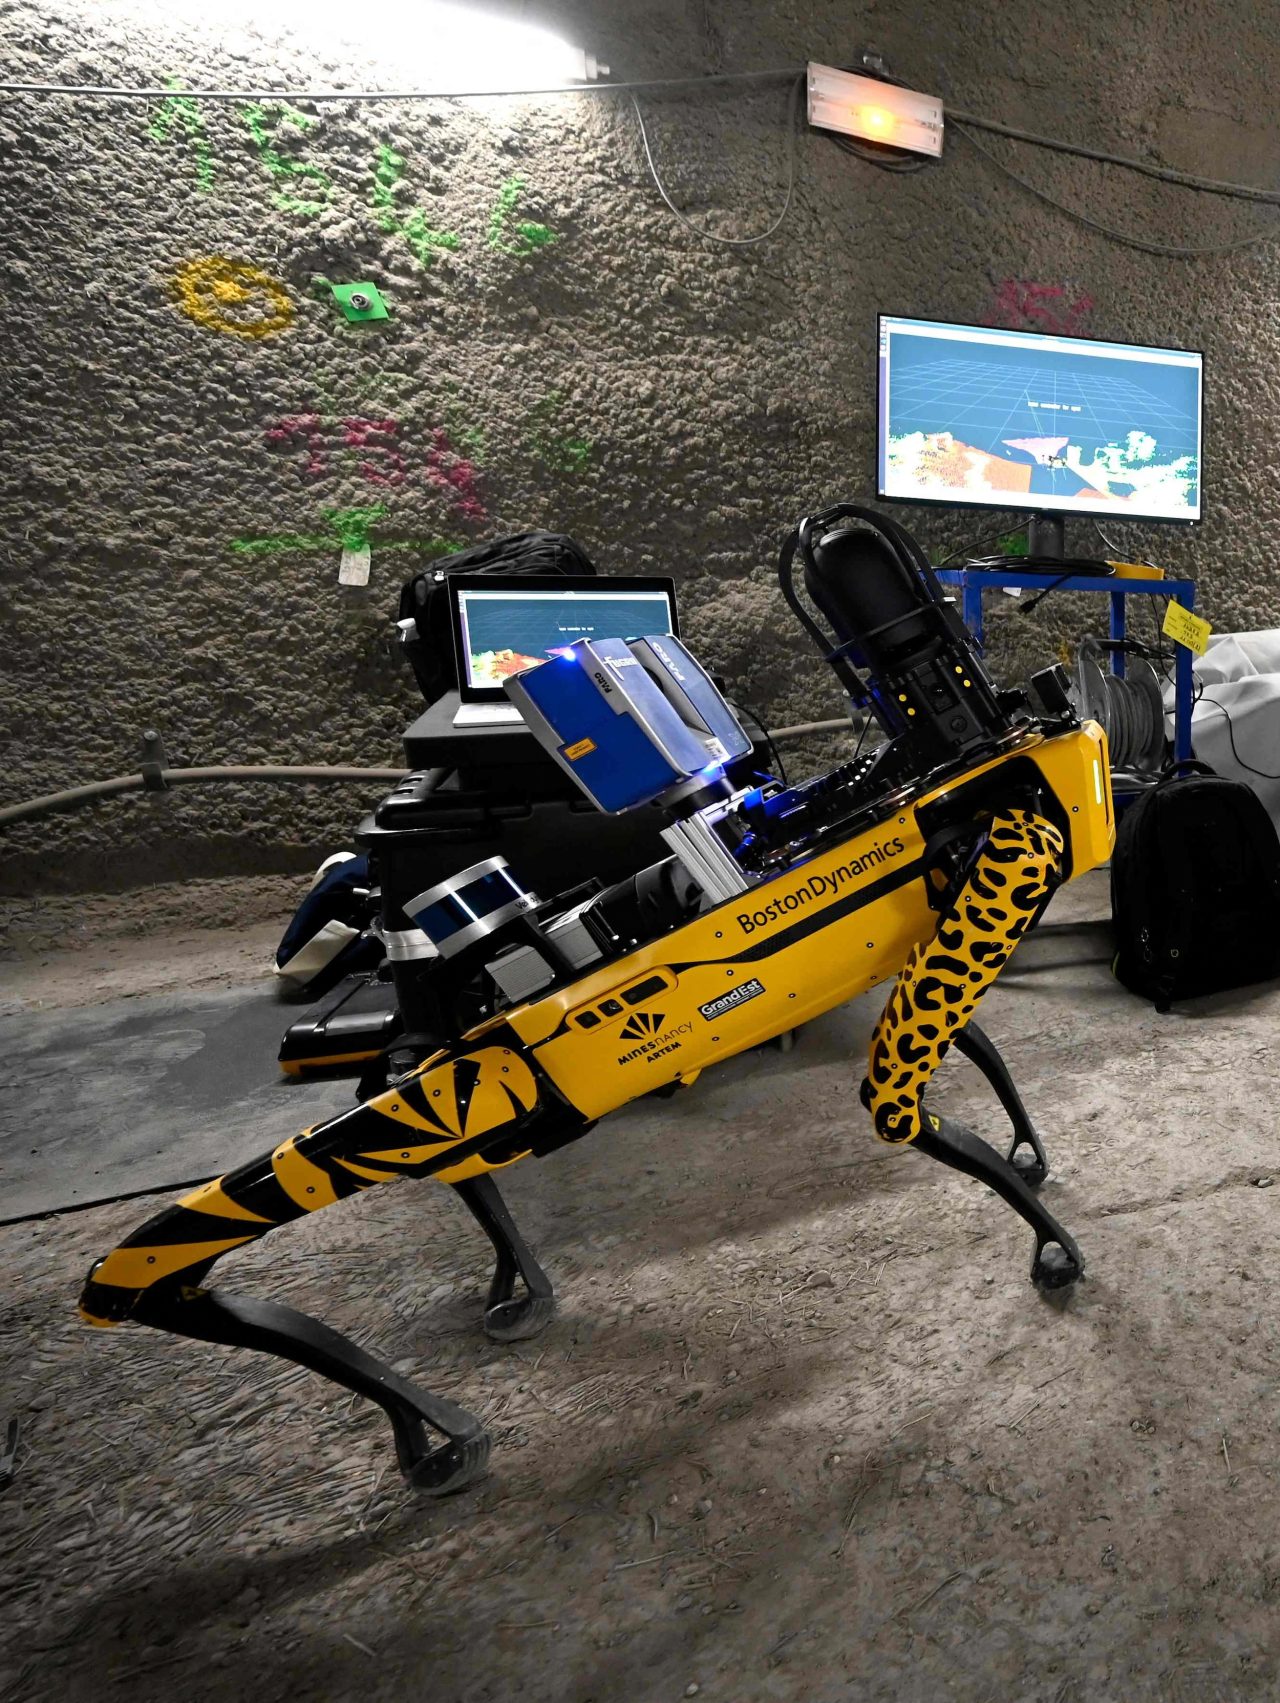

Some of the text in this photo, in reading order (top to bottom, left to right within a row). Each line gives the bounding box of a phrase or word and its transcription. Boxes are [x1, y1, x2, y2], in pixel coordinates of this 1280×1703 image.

[652, 642, 686, 681] FARO
[594, 672, 613, 694] FARO
[646, 1041, 682, 1063] ARTEM
